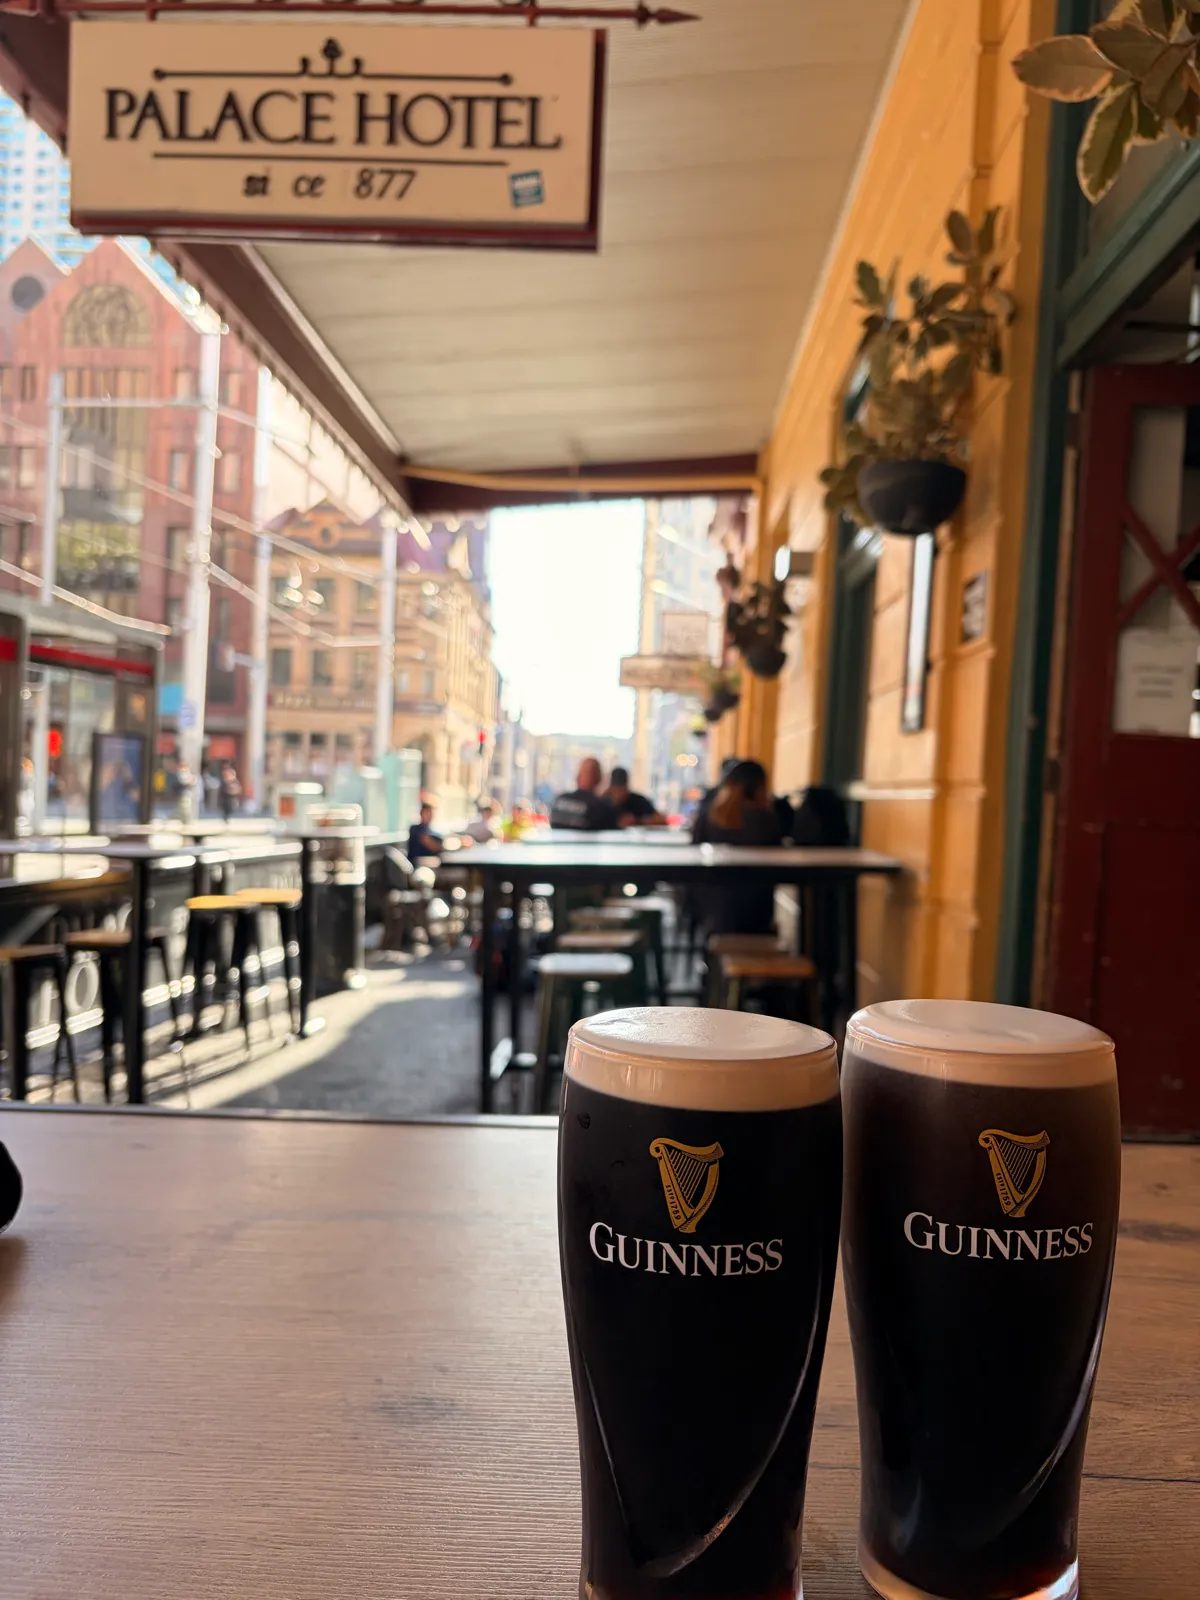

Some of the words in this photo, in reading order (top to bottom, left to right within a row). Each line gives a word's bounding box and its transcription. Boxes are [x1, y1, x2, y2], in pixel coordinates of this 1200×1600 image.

[105, 88, 336, 144] PALACE
[353, 92, 563, 150] HOTEL
[341, 168, 417, 201] 877
[589, 1221, 784, 1277] GUINNESS
[903, 1211, 1094, 1261] GUINNESS
